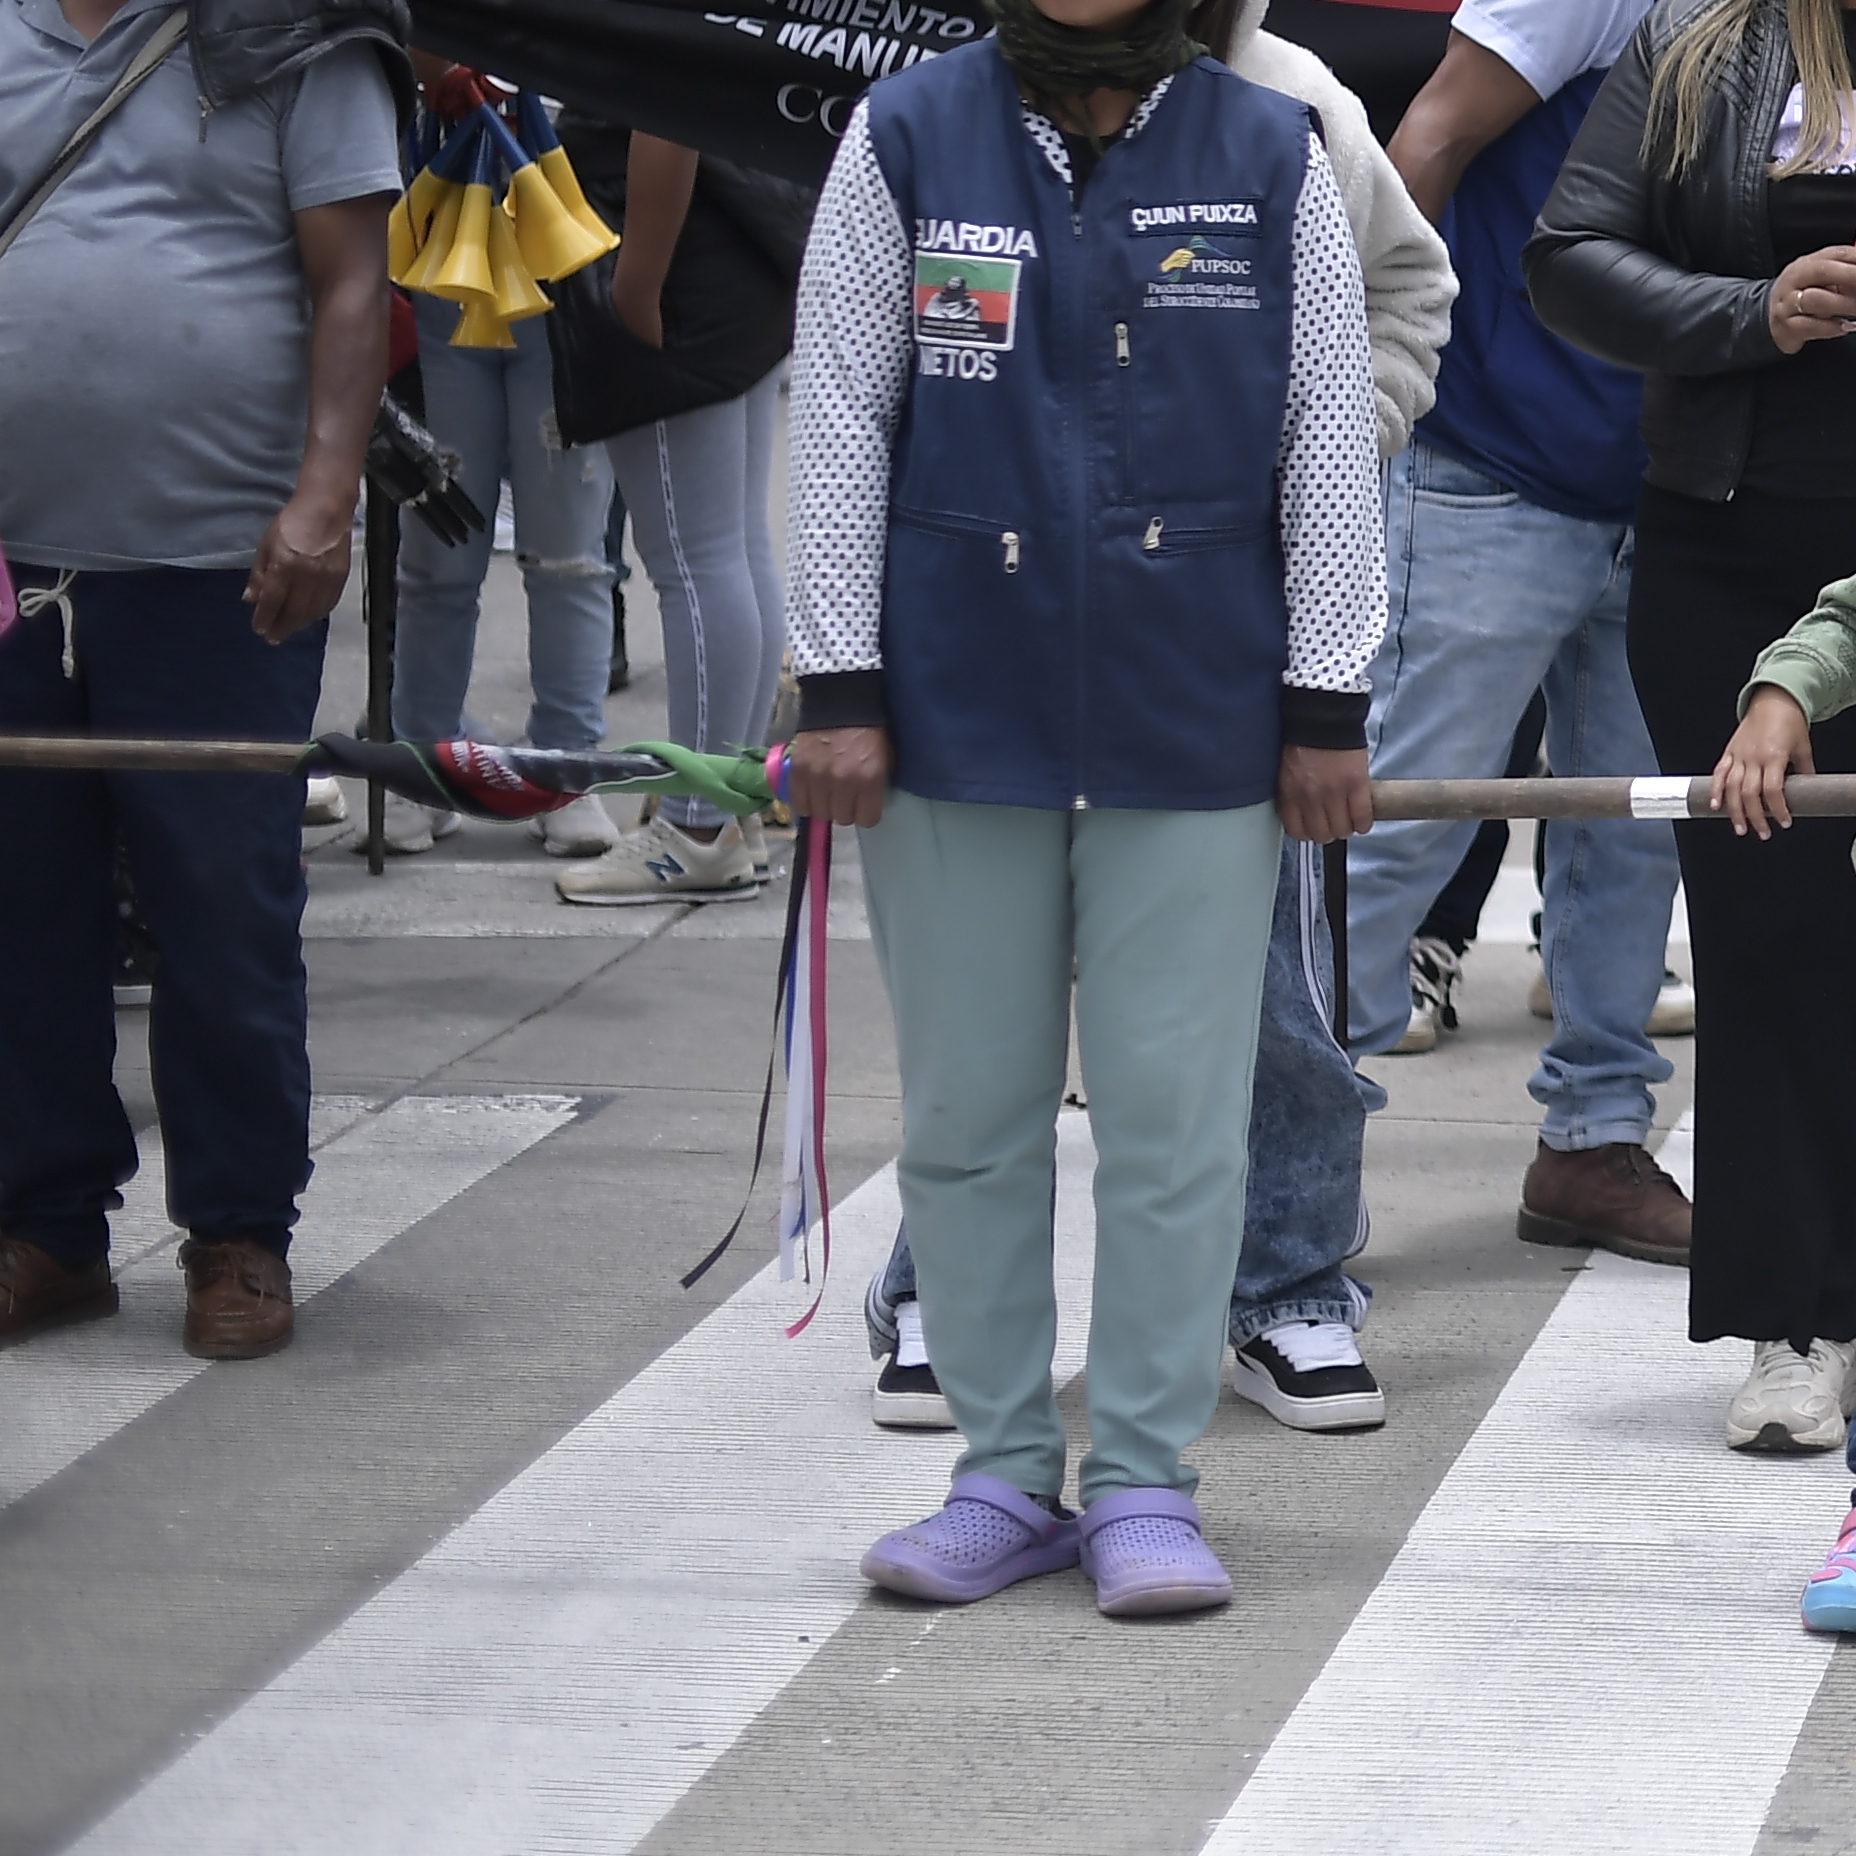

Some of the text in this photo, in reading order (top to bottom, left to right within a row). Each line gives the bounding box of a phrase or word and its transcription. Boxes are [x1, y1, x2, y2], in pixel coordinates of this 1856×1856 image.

[1132, 204, 1258, 232] ÇUUN PUIXZA
[1191, 259, 1252, 275] PUPSOC
